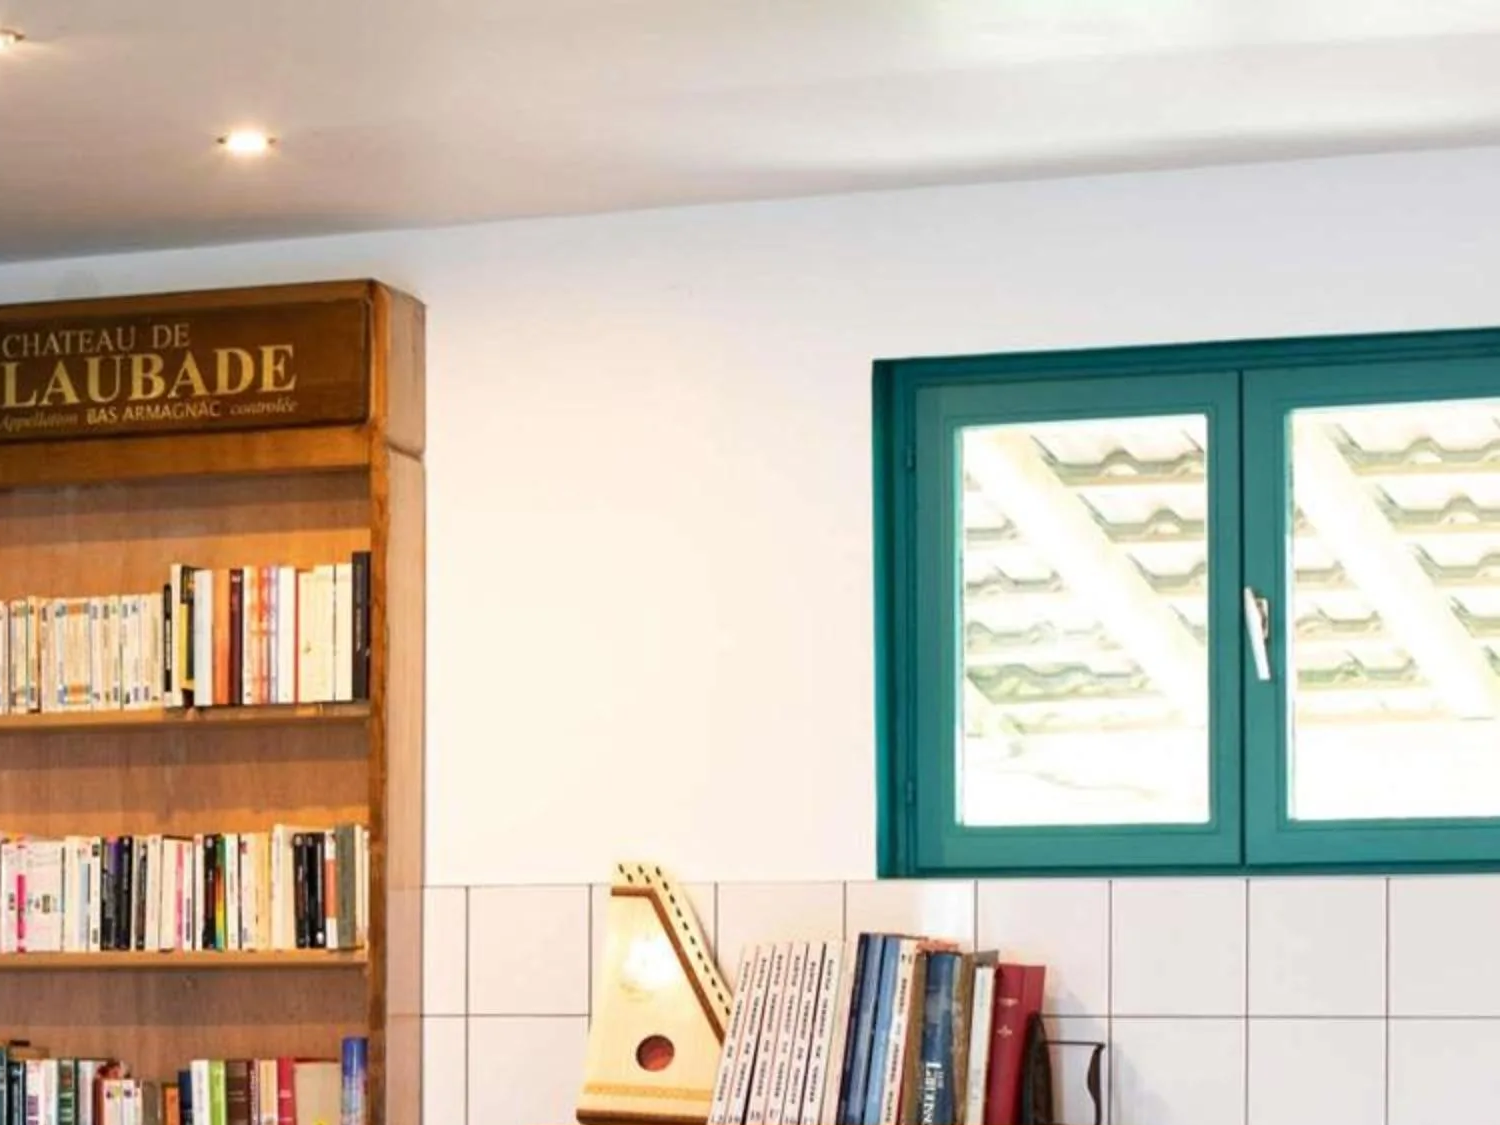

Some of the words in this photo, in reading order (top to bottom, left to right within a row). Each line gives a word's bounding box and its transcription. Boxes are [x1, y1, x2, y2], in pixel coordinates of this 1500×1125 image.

[1, 325, 136, 358] CHATEAU
[152, 323, 191, 349] DE
[0, 344, 298, 409] LAUBADE
[86, 404, 118, 425] BAS
[121, 400, 221, 421] ARMAGNAC
